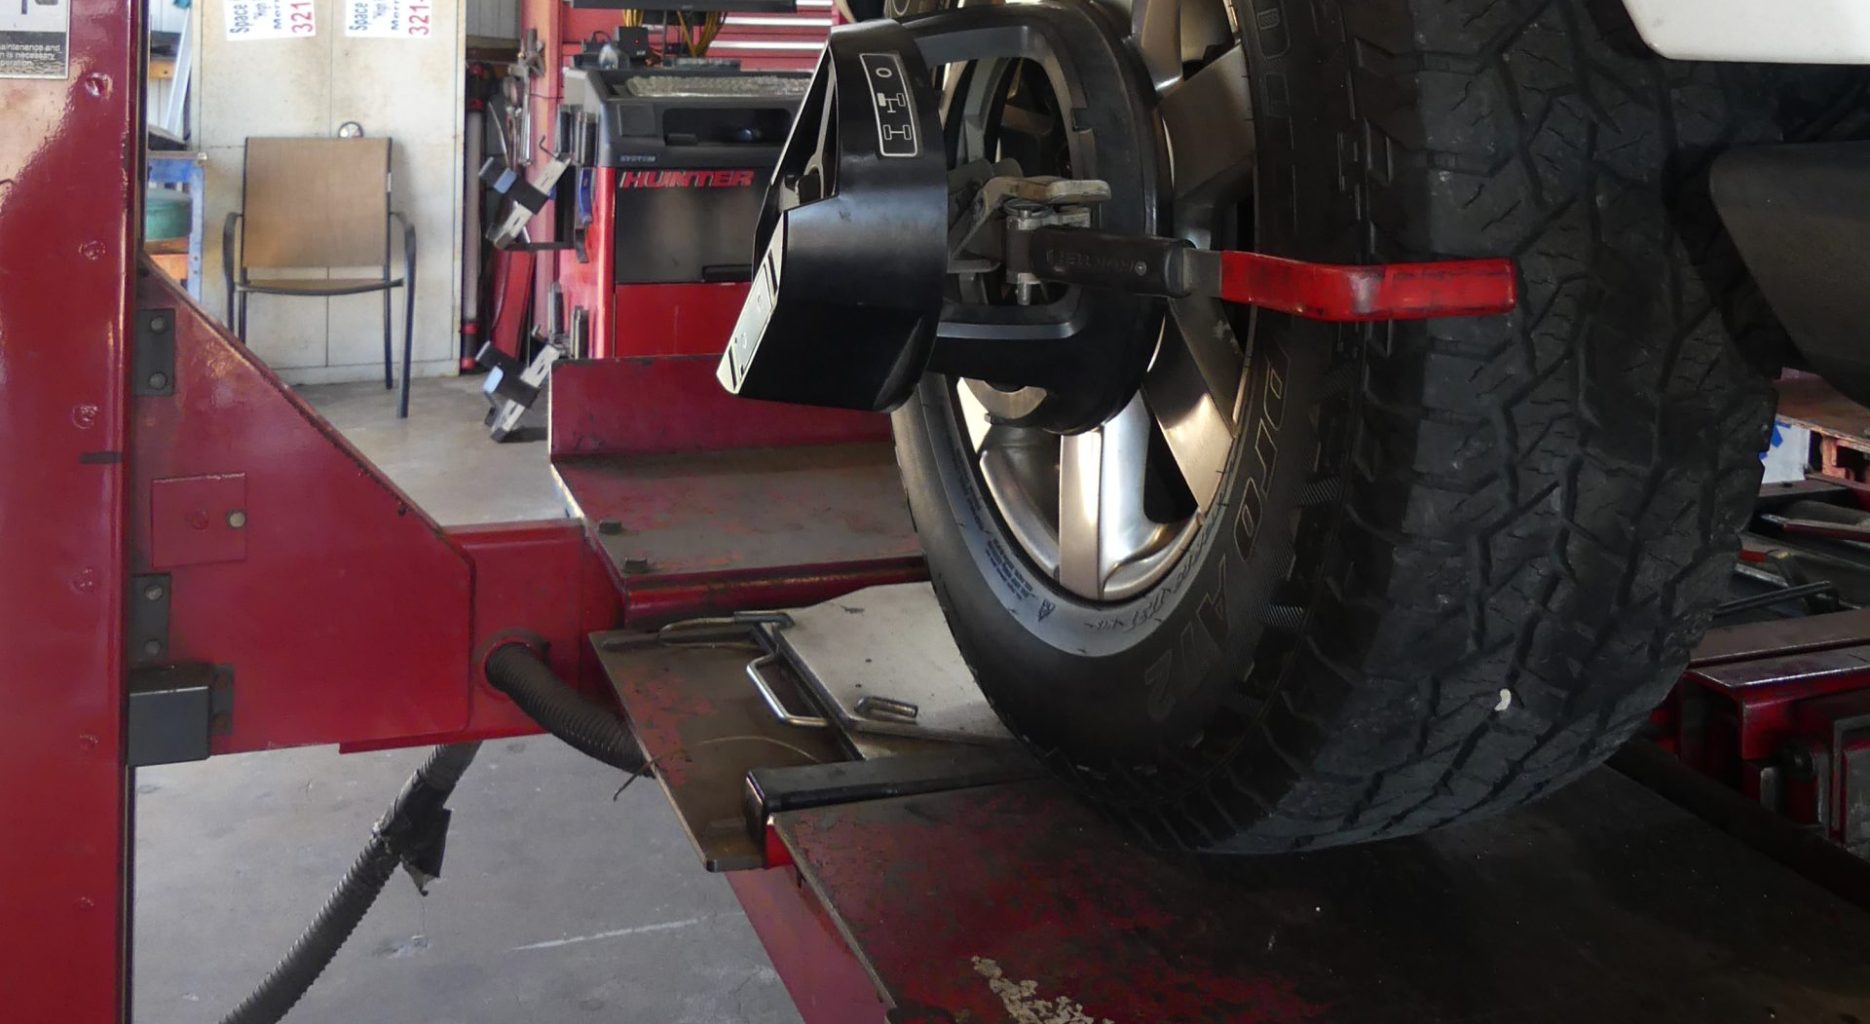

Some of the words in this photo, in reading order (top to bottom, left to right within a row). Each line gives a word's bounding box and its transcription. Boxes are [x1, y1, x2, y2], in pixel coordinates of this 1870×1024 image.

[229, 4, 253, 34] Space
[349, 2, 372, 31] Space
[619, 170, 754, 188] HUNTER
